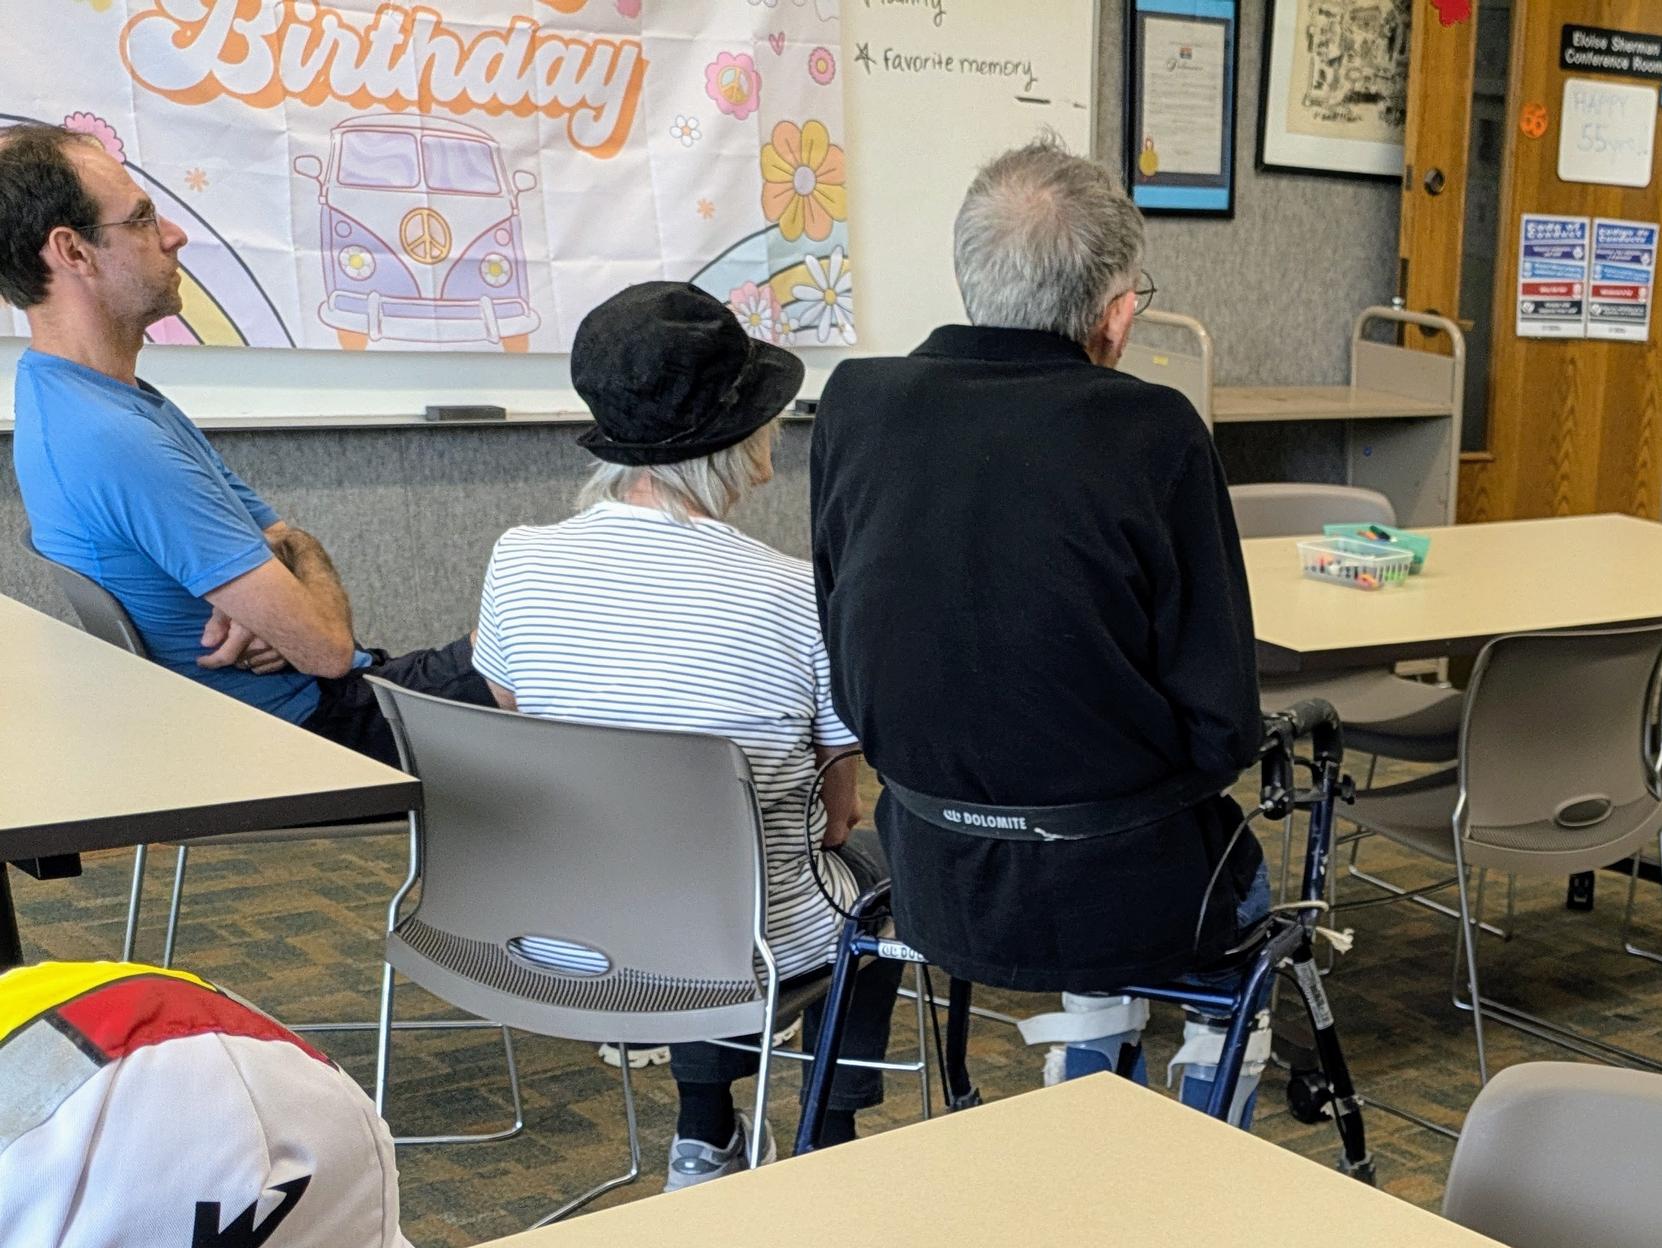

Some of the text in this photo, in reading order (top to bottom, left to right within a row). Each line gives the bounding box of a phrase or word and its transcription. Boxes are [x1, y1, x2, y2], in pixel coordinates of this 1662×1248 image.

[1564, 48, 1630, 70] Conference
[118, 0, 650, 160] Birthday
[959, 57, 1038, 92] memory
[963, 811, 1028, 830] DOLOMITE
